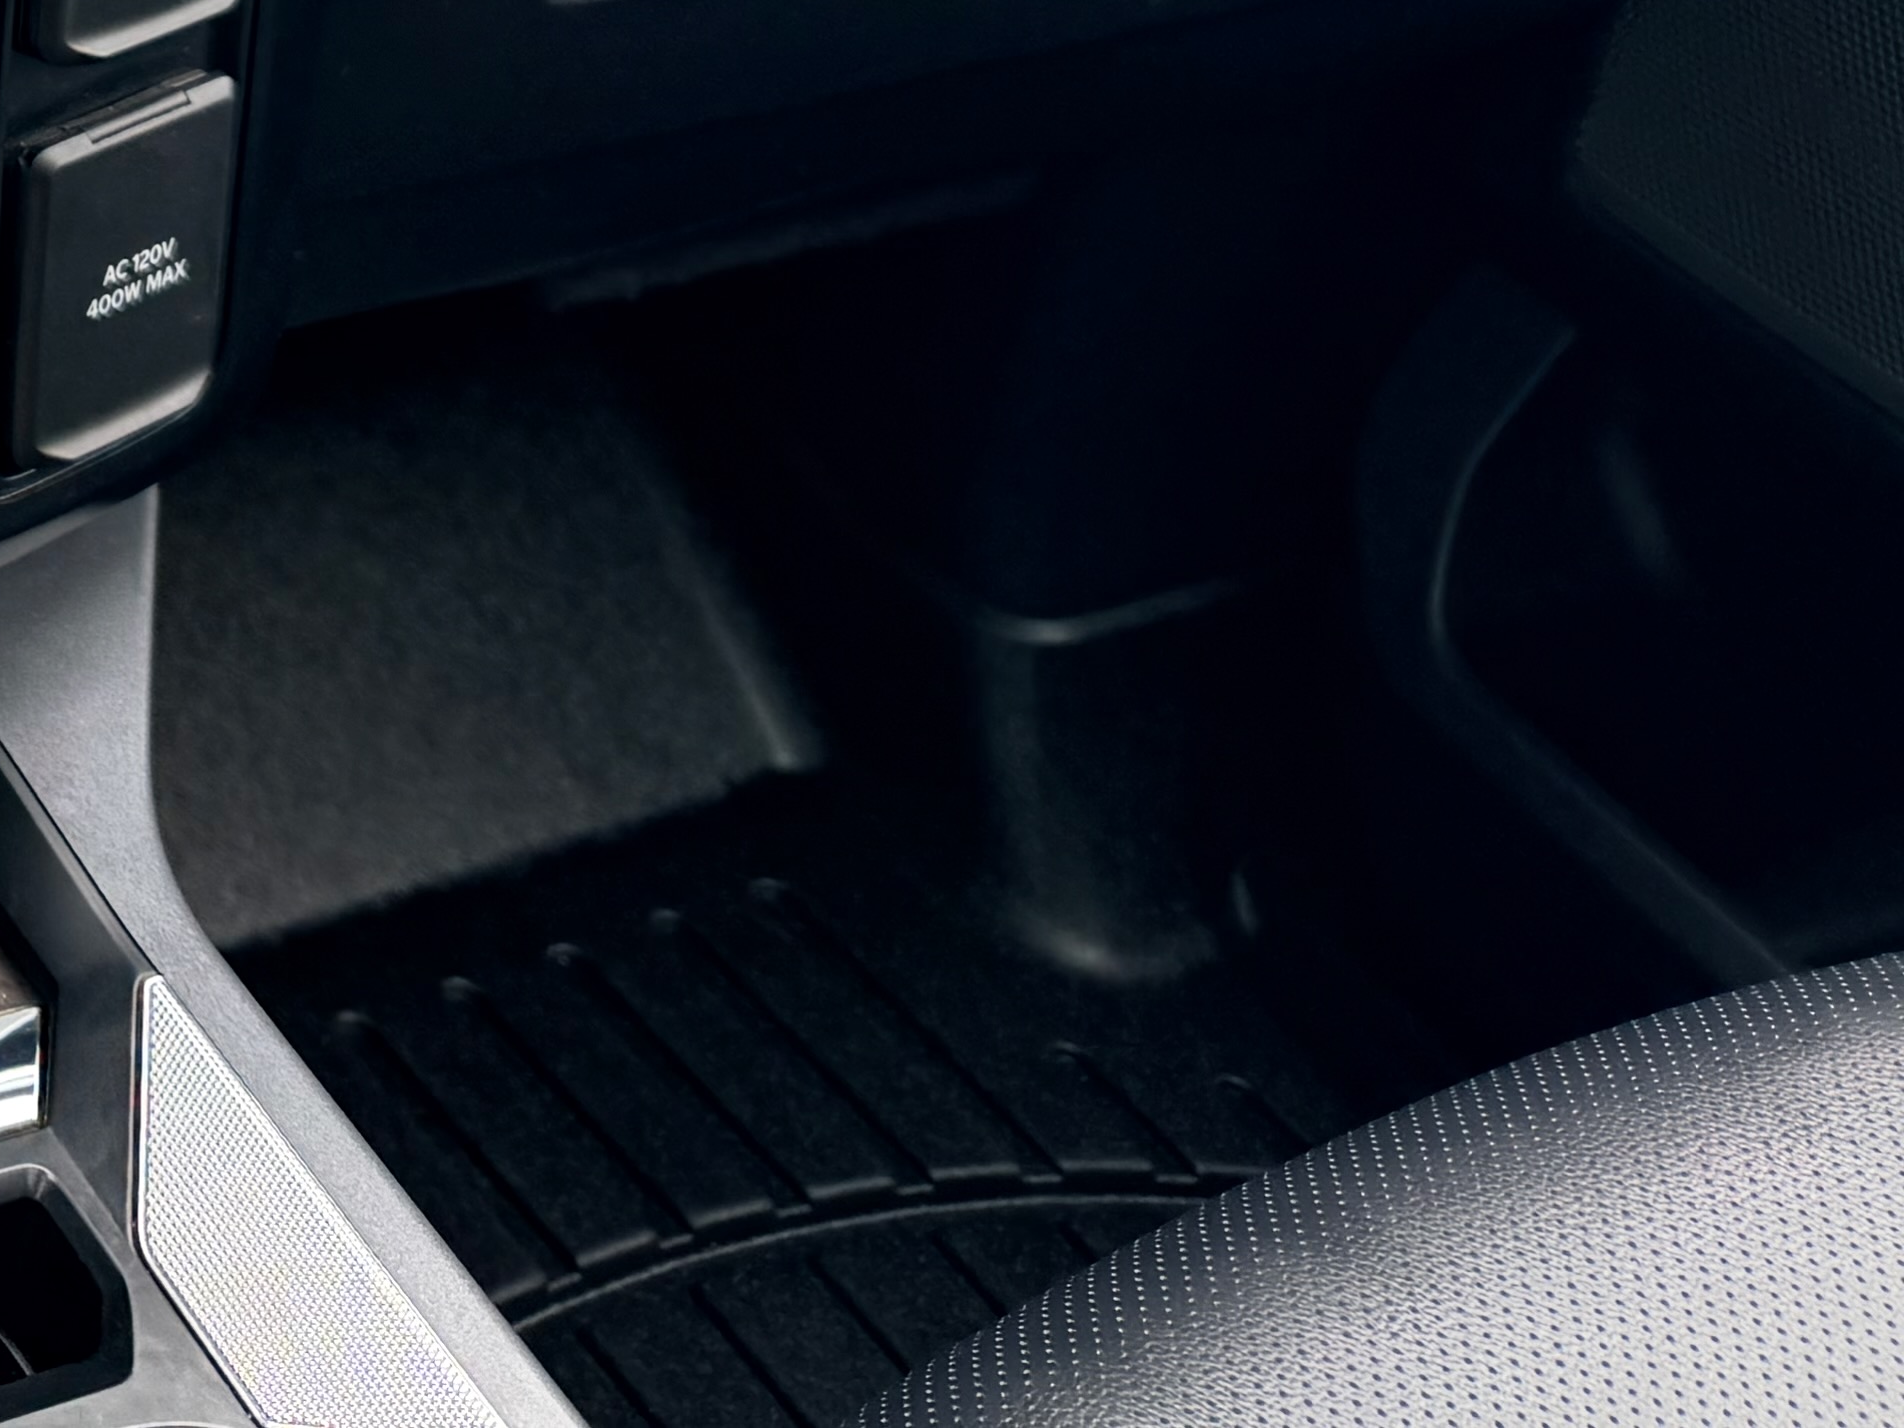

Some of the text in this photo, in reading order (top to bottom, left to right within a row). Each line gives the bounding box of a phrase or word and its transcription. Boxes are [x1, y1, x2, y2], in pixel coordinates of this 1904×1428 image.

[85, 257, 190, 320] 400W MAX
[102, 236, 178, 288] AC 120V
